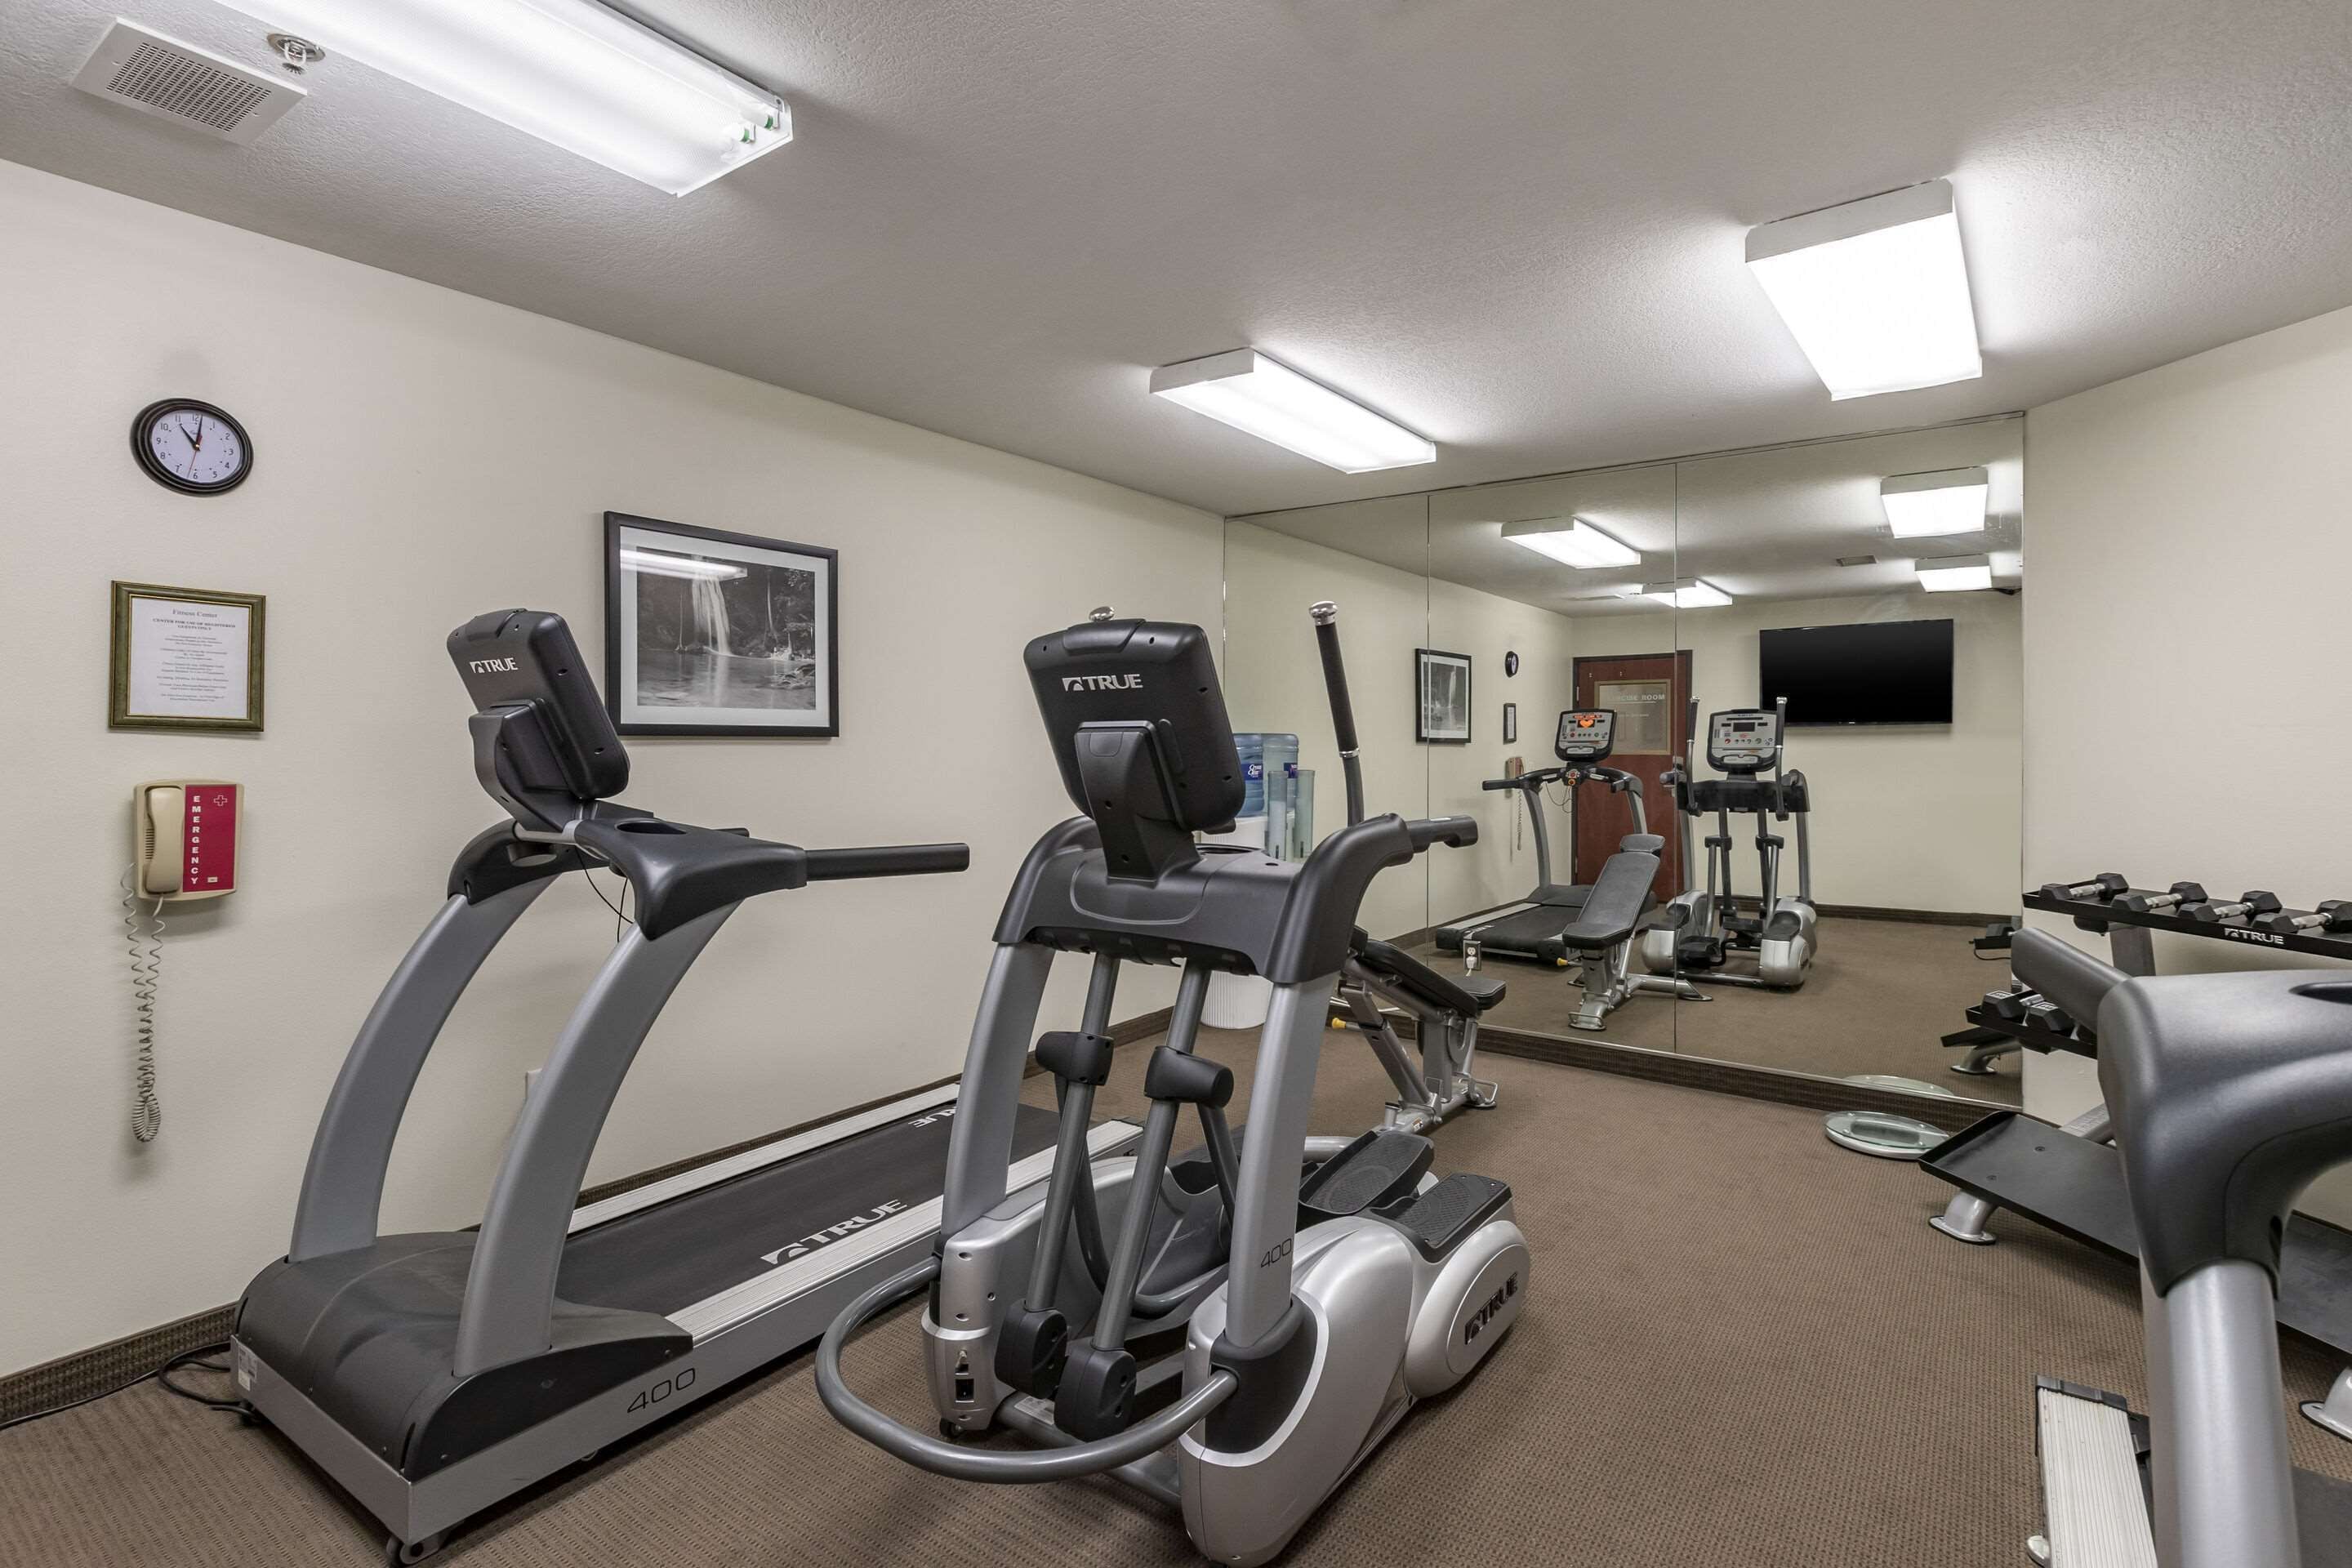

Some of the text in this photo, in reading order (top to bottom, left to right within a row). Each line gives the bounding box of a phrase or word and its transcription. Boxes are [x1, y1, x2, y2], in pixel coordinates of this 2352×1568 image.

[175, 414, 181, 422] 11
[175, 465, 180, 473] 7
[481, 657, 519, 673] TRUE
[1082, 674, 1143, 691] TRUE
[191, 795, 202, 884] EMERGENCY
[2238, 929, 2284, 945] TRUE
[800, 1199, 907, 1249] TRUE
[1260, 1238, 1292, 1268] 400
[1480, 1271, 1517, 1325] TRUE
[626, 1367, 697, 1414] 400
